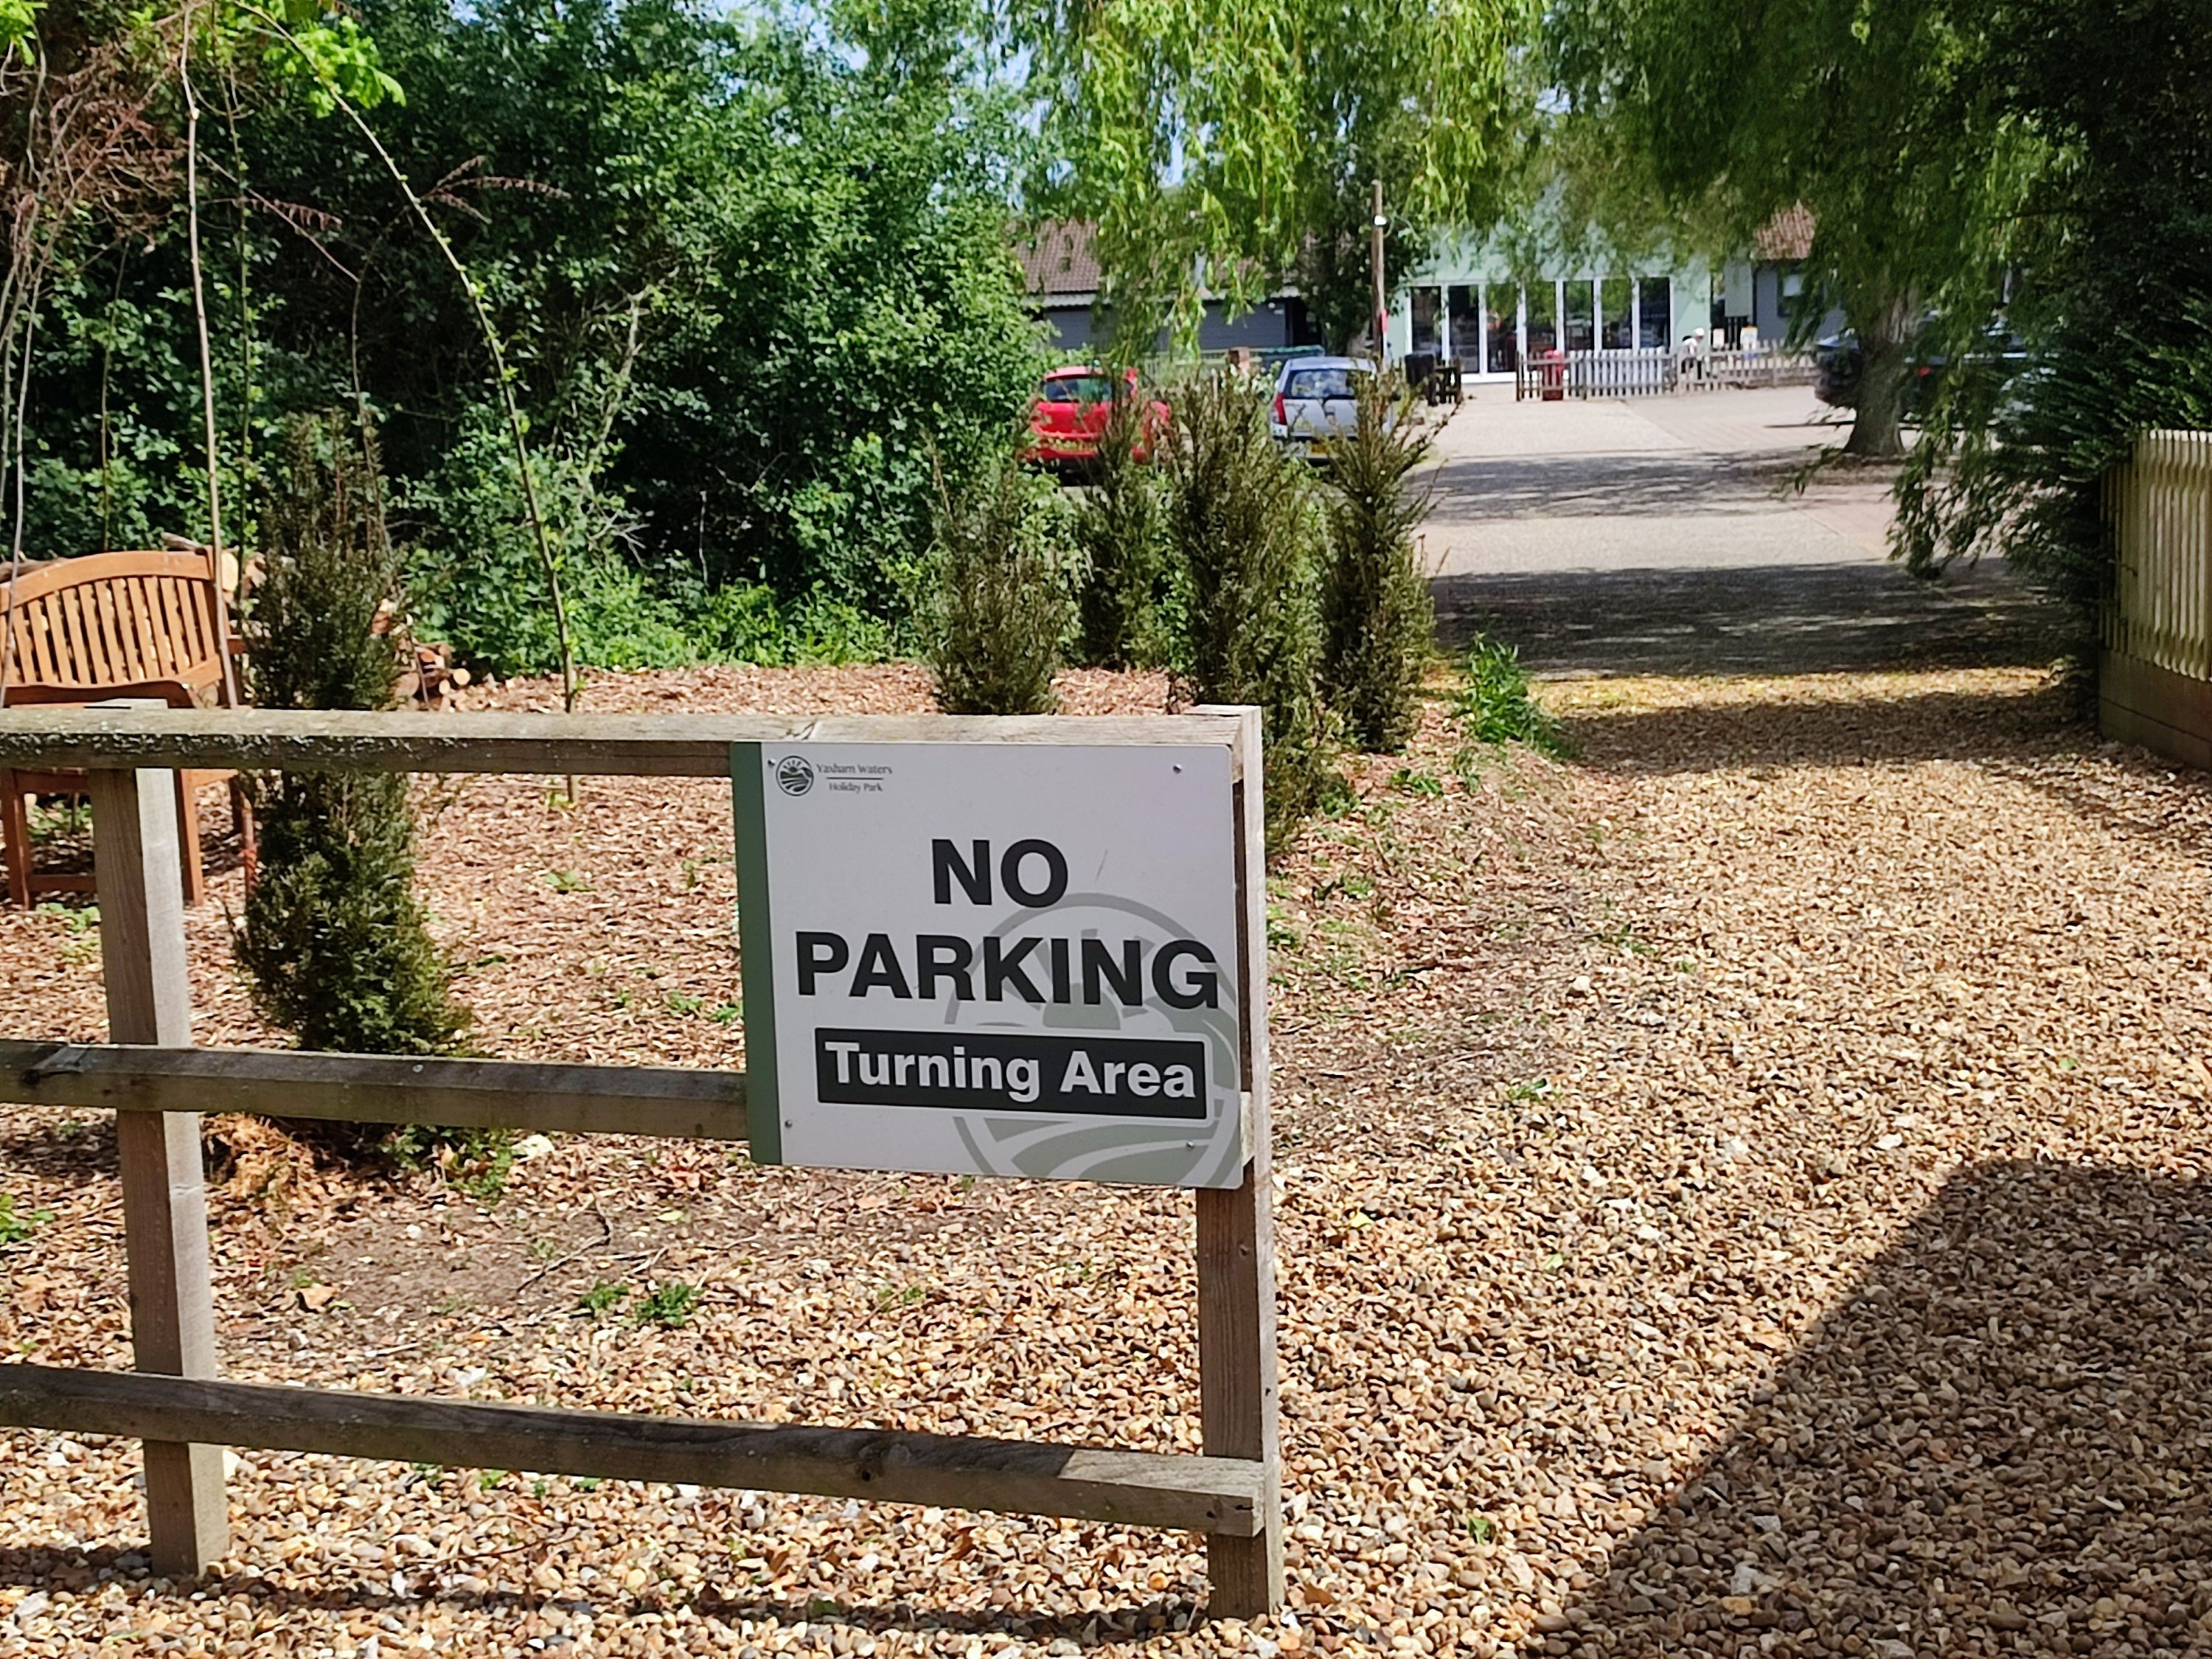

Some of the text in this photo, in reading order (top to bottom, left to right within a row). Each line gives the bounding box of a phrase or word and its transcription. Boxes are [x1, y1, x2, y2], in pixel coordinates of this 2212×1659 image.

[829, 782, 883, 793] Holiday Park
[858, 764, 893, 774] Waters
[931, 838, 1068, 908] NO
[795, 931, 1220, 1009] PARKING
[824, 1040, 1196, 1102] Turning Area
